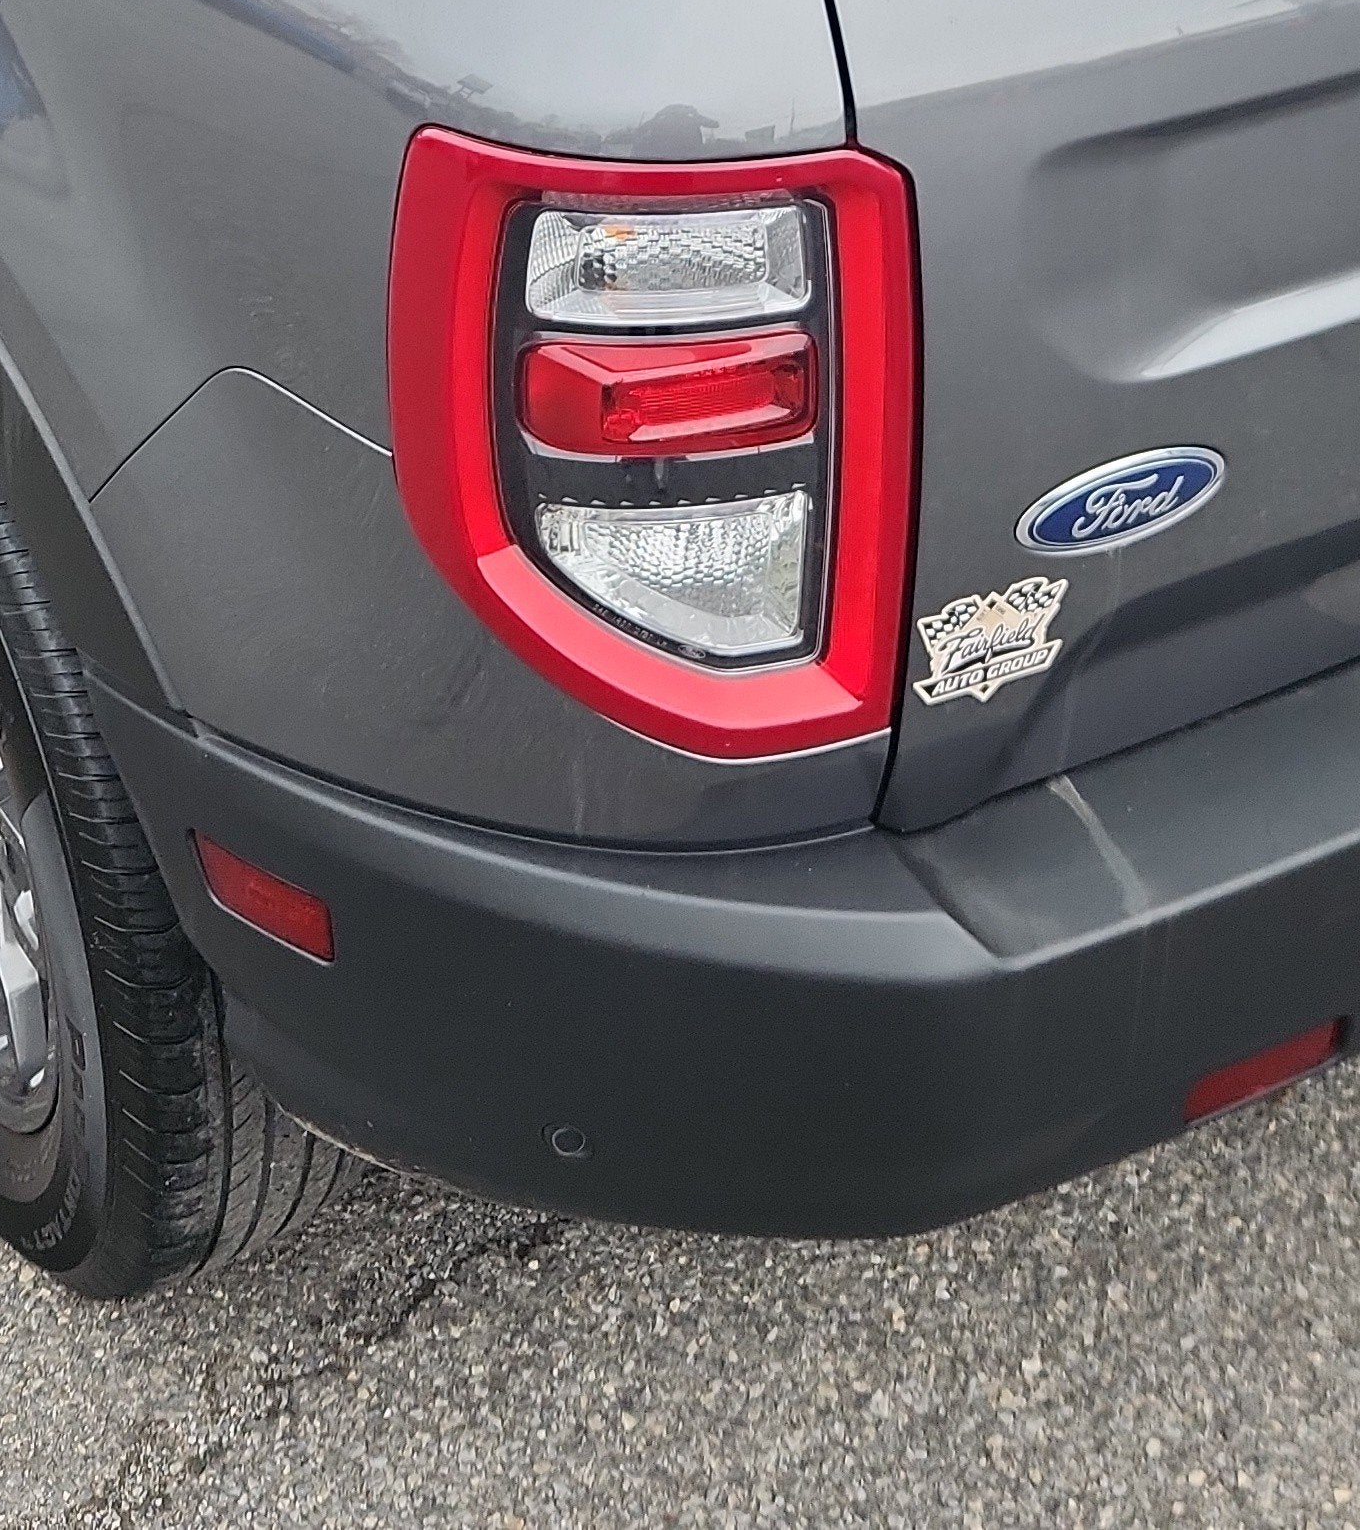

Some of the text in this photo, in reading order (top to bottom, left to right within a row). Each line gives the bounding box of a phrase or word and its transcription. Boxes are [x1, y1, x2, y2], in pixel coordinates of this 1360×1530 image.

[1071, 472, 1185, 541] Ford
[931, 647, 1050, 698] AUTO GROUP
[937, 613, 1045, 677] Fairfield
